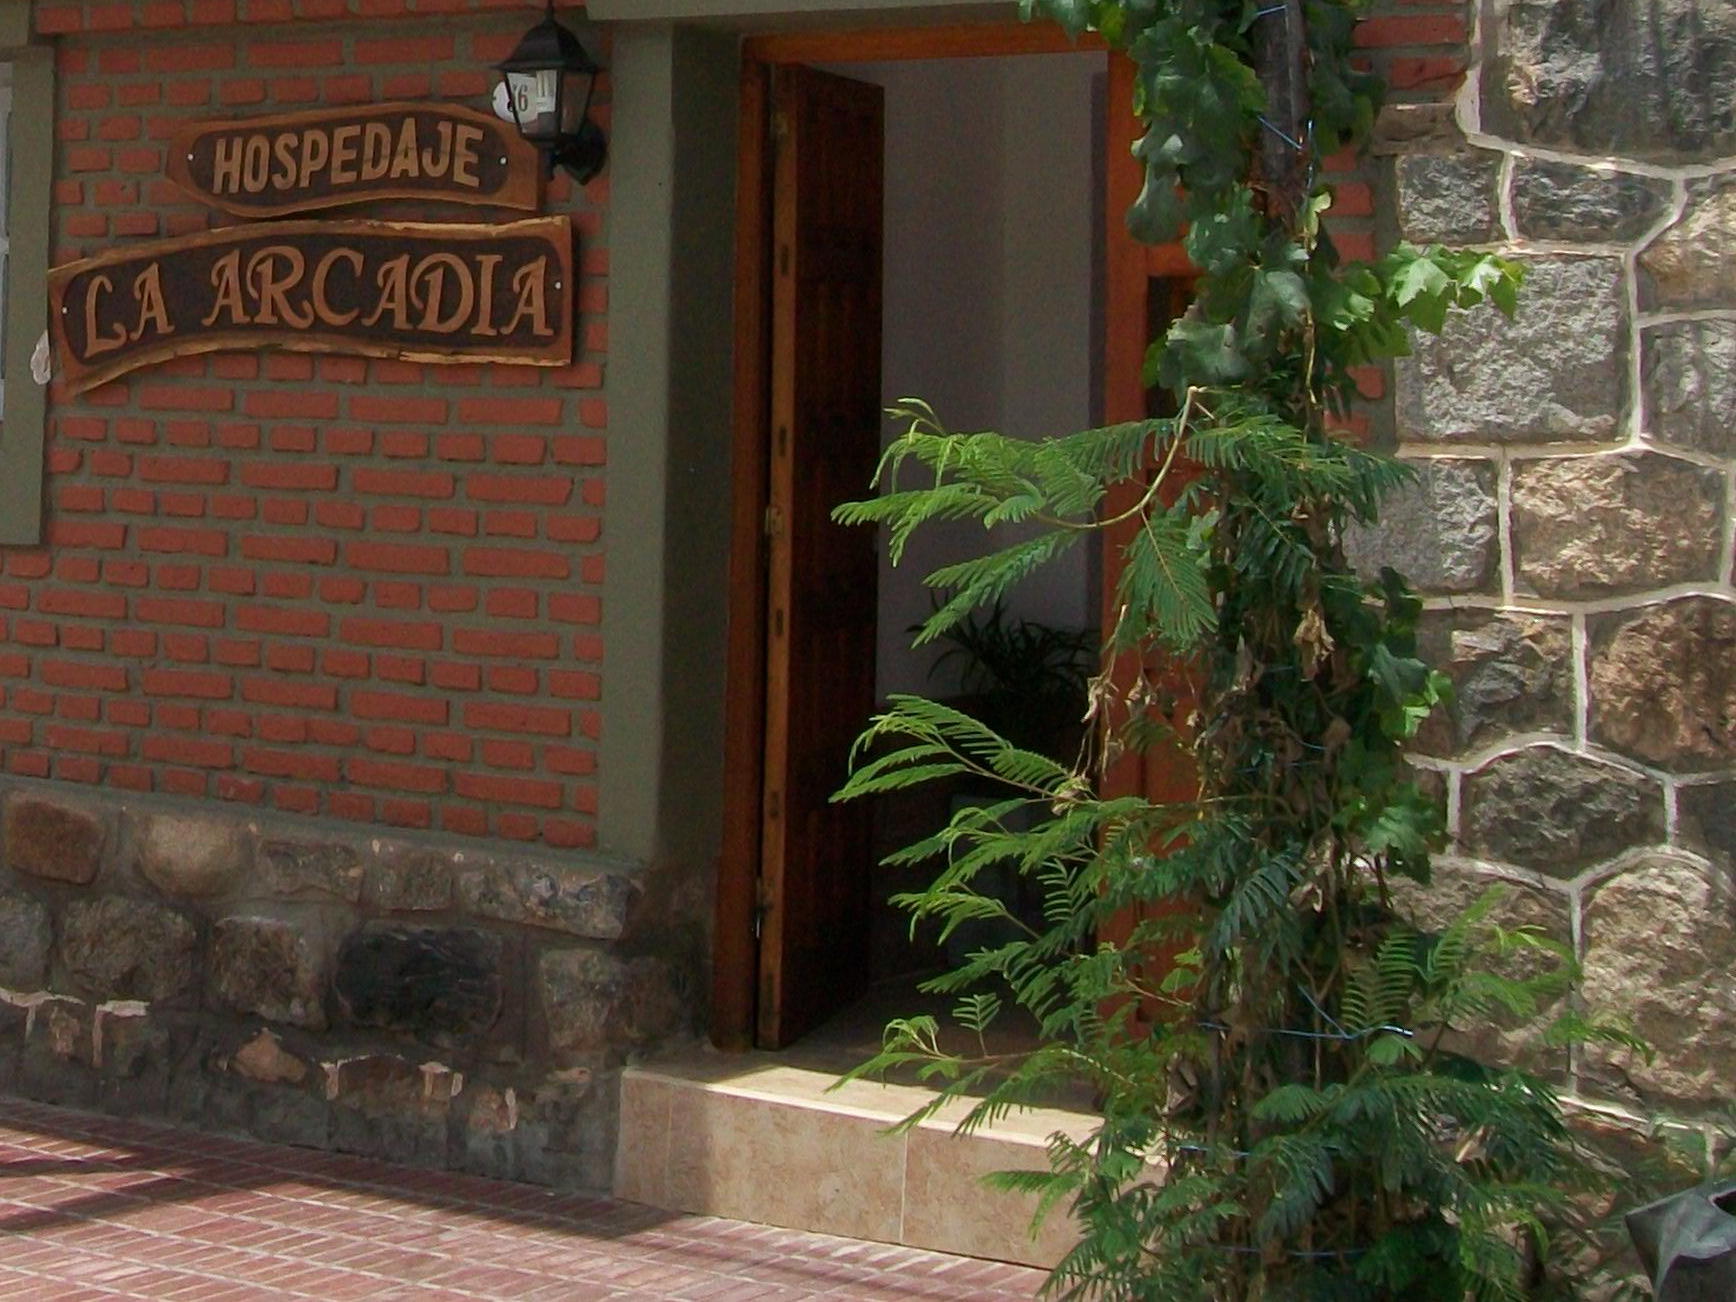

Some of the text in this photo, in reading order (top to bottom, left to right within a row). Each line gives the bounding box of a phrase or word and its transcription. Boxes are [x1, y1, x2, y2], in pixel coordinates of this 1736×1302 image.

[212, 117, 484, 195] HOSPEDAJE
[82, 244, 555, 359] LA ARCADIA
